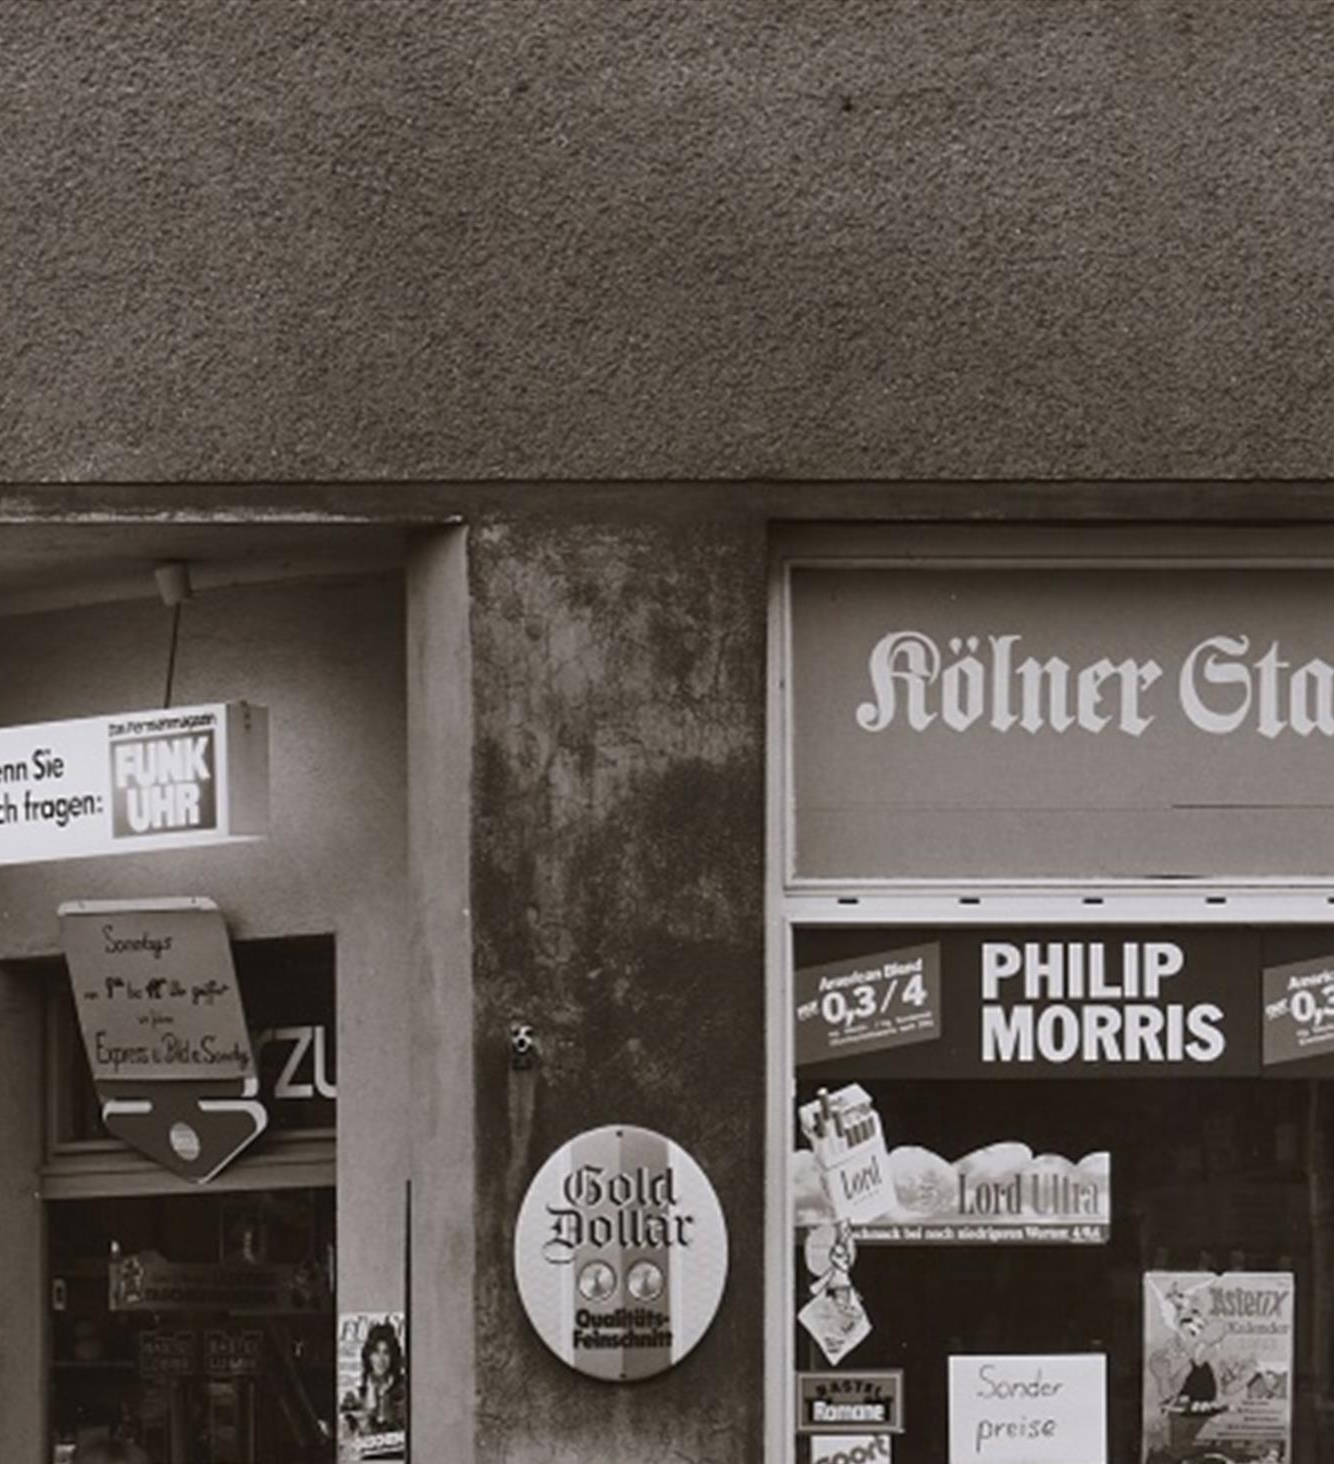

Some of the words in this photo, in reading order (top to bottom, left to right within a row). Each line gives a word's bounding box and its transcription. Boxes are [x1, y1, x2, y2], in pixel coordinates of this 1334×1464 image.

[854, 629, 1164, 738] Kölner
[32, 748, 65, 781] Sie
[113, 735, 210, 789] FUNK
[23, 793, 104, 828] fragen:
[125, 782, 202, 833] UHR
[980, 940, 1185, 1000] PHILIP
[980, 1003, 1227, 1063] MORRIS
[563, 1162, 679, 1207] Gold
[956, 1171, 1022, 1217] Lord
[1031, 1171, 1100, 1216] Ultra
[541, 1202, 695, 1265] Dollar
[1208, 1286, 1290, 1317] Asterix
[976, 1364, 1064, 1399] Sonder
[812, 1400, 885, 1421] Romane
[974, 1415, 1058, 1454] preise
